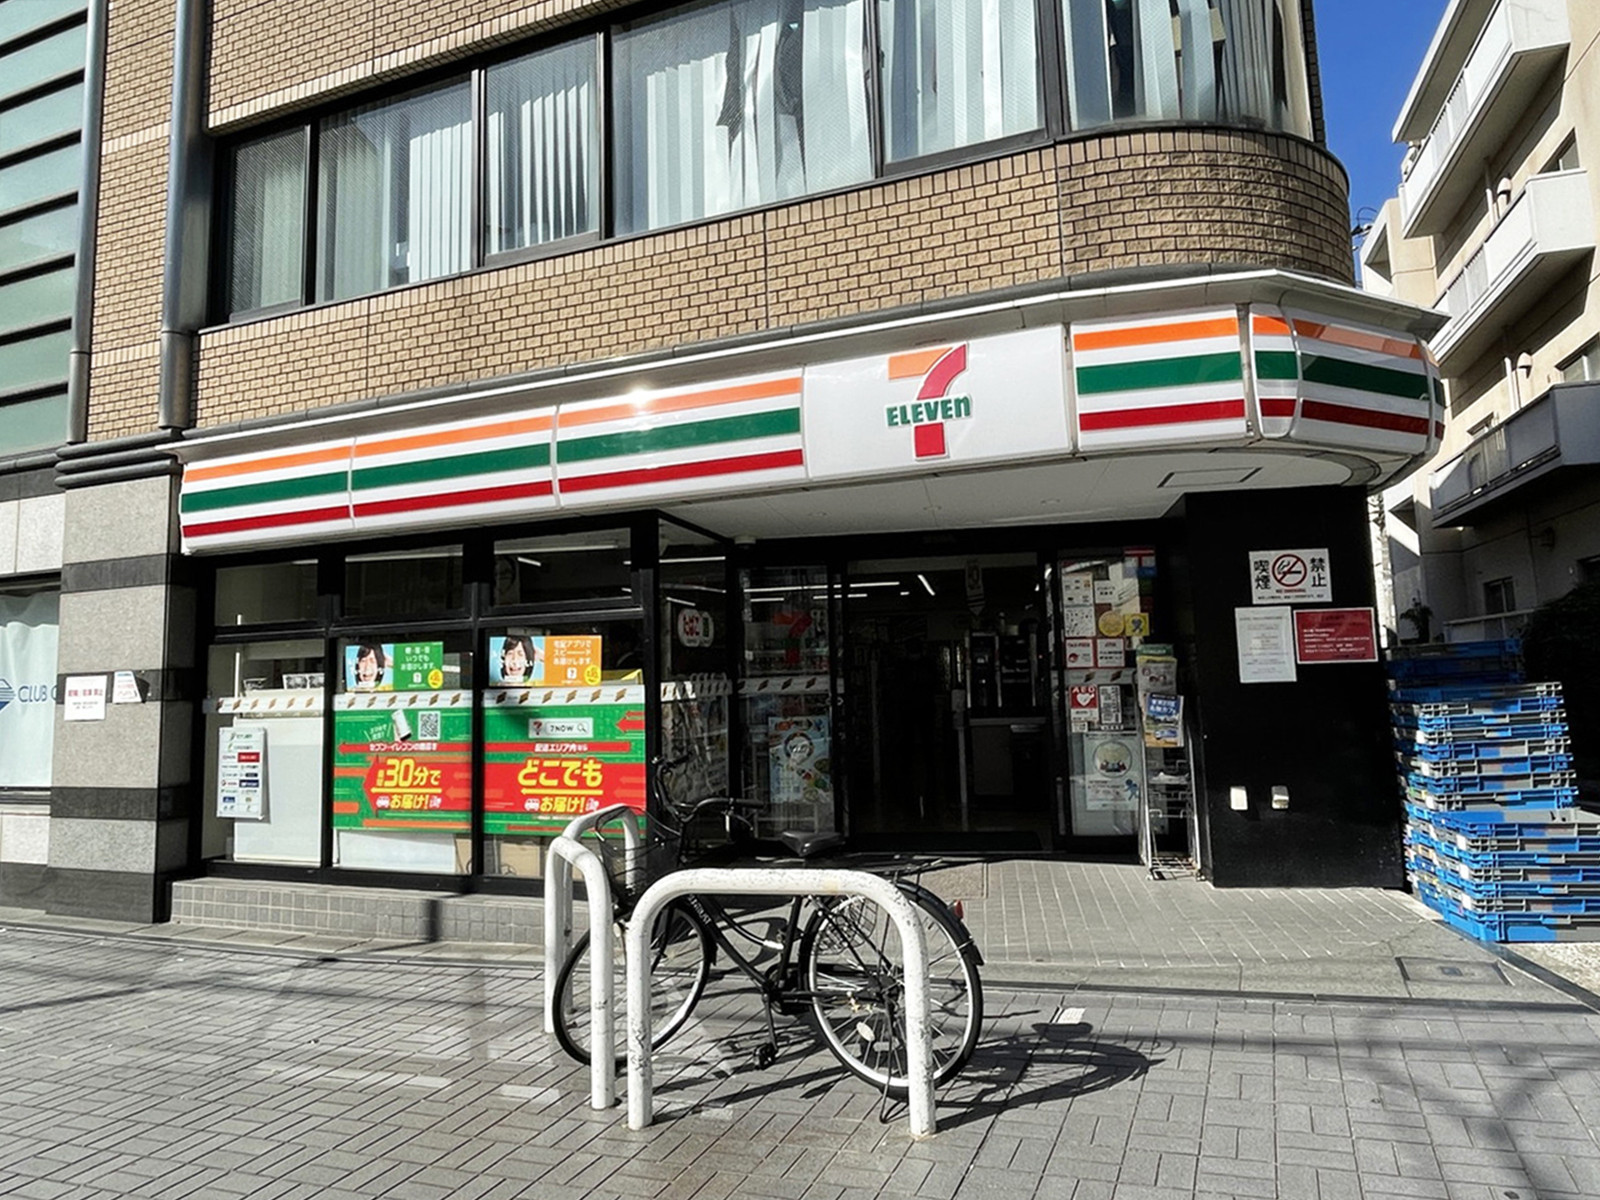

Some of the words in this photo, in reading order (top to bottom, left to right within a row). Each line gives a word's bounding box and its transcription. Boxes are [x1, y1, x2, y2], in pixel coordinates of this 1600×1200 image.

[1310, 556, 1327, 588] 禁止
[18, 685, 48, 703] CLUB
[1072, 685, 1096, 693] AED
[517, 759, 603, 788] どこでも
